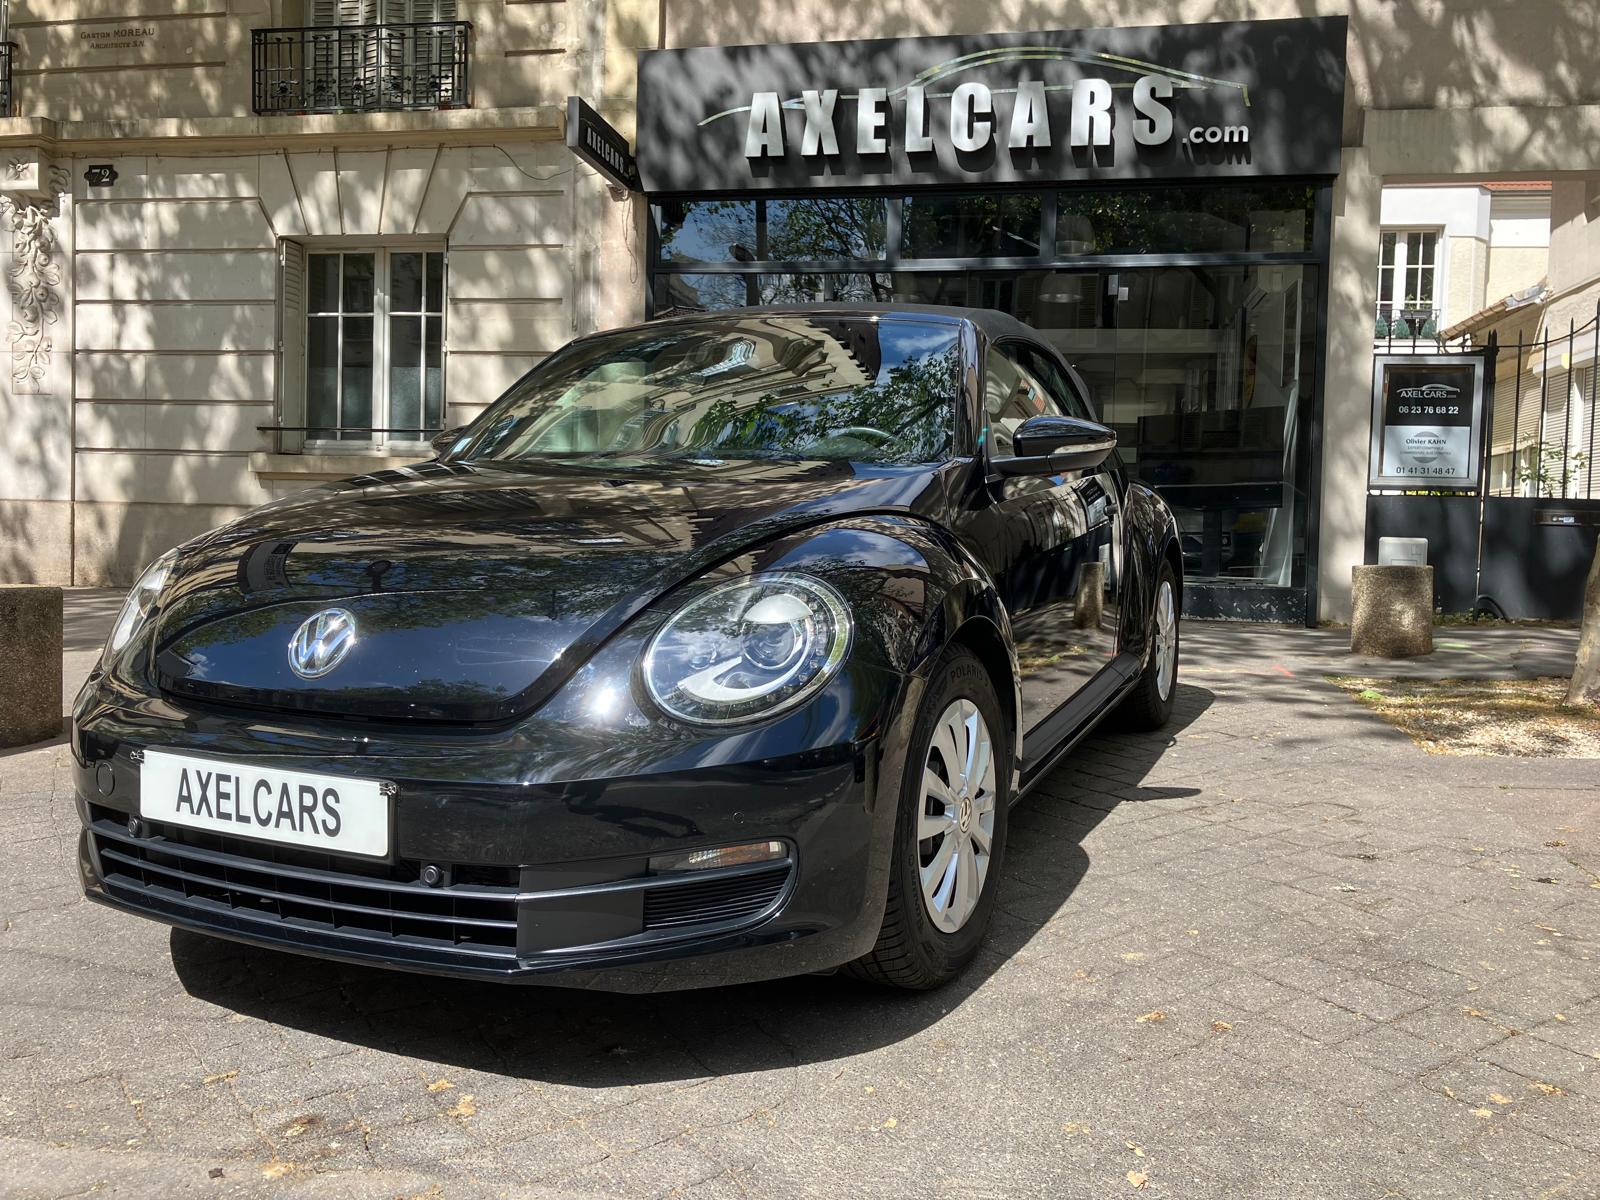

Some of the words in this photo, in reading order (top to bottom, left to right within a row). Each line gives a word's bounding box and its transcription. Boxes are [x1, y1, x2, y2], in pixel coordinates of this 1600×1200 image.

[113, 27, 156, 38] MOREAU
[744, 74, 1174, 158] AXELCARS
[1182, 124, 1250, 144] .com
[586, 126, 625, 175] AXELCARS
[91, 168, 111, 183] 72
[1400, 390, 1447, 399] AXELCARS
[1398, 405, 1409, 414] 06
[1411, 406, 1422, 414] 23
[1423, 406, 1434, 414] 76
[1435, 406, 1447, 414] 68
[1448, 406, 1459, 415] 22
[1396, 466, 1405, 474] 01
[1408, 466, 1418, 475] 41
[1420, 467, 1430, 475] 31
[1432, 467, 1443, 475] 48
[1444, 467, 1456, 475] 47
[176, 767, 342, 838] AXELCARS
